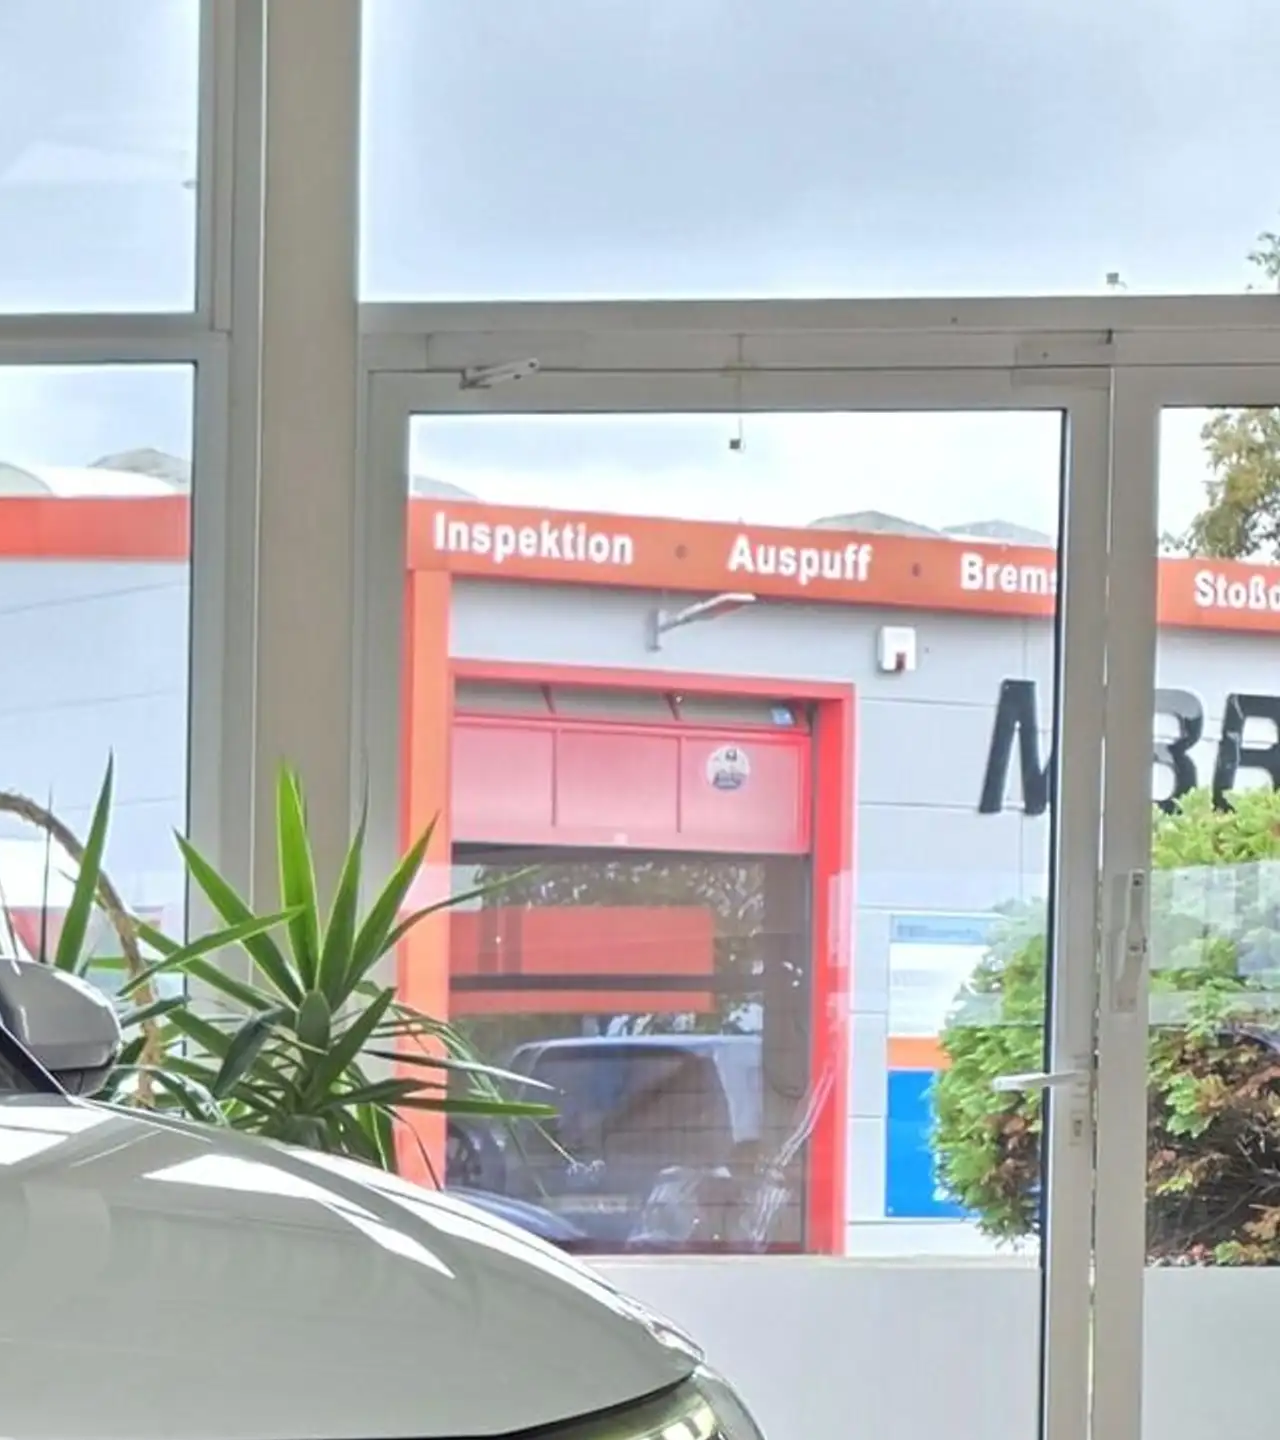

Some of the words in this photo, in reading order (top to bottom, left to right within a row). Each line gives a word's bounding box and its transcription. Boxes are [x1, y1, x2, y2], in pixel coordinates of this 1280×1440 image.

[434, 511, 633, 565] Inspektion
[727, 533, 873, 586] Auspuff
[959, 551, 1057, 595] Brem
